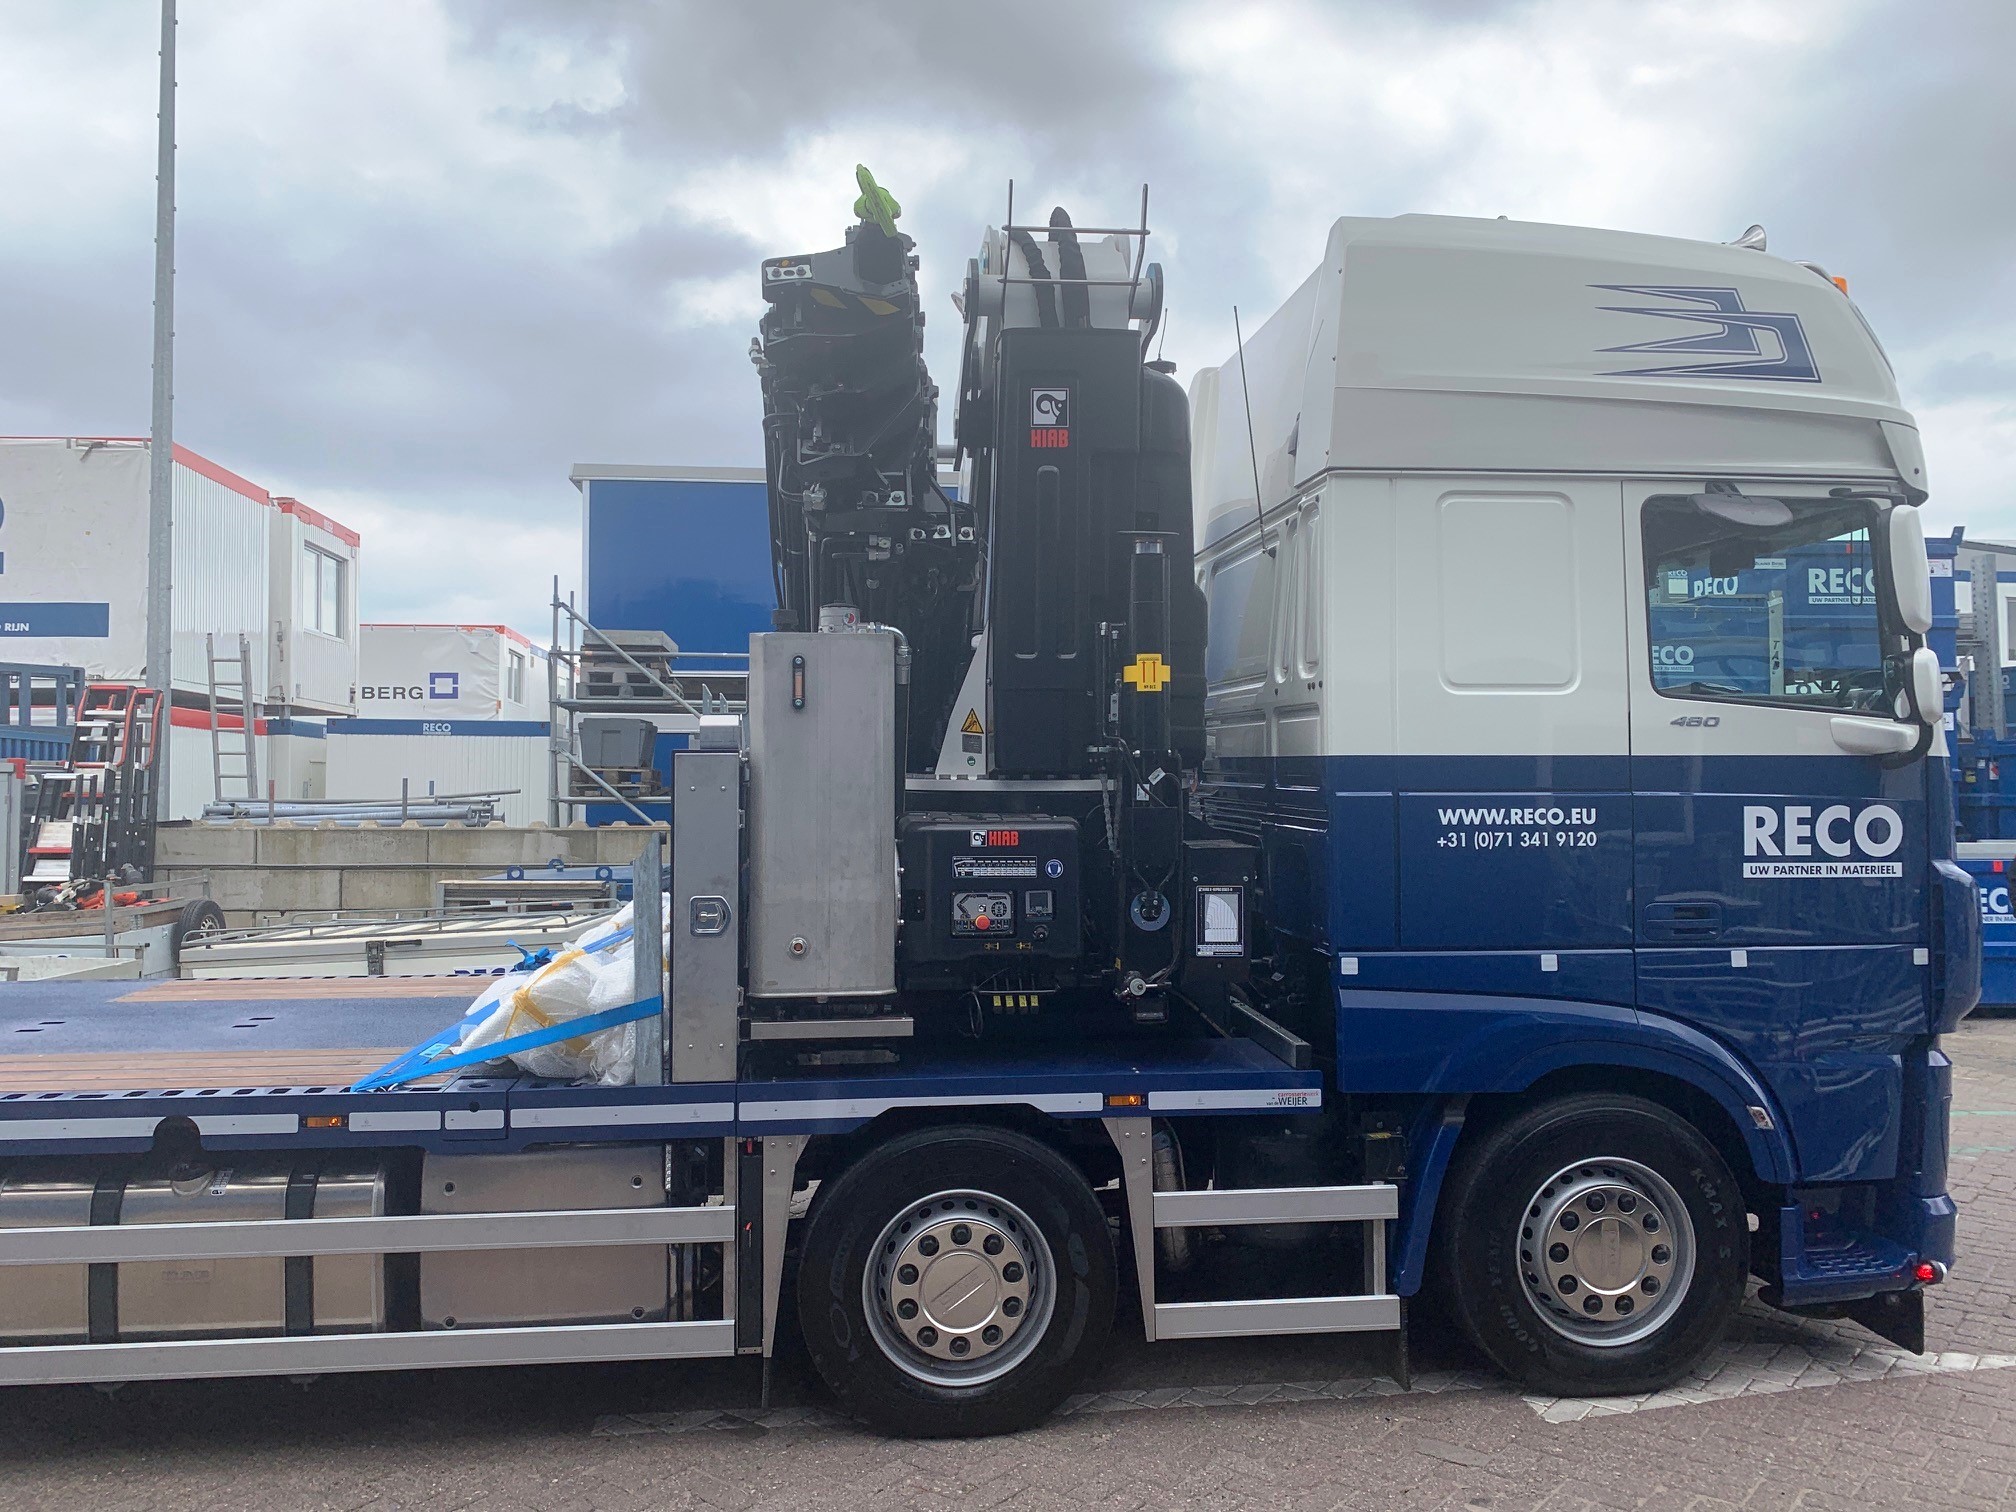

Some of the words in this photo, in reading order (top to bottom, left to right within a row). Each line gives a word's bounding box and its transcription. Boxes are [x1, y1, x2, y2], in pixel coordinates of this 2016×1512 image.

[1031, 429, 1069, 448] HIAB
[4, 622, 30, 632] RIJN
[361, 686, 424, 700] BERG
[422, 722, 452, 732] RECO
[1670, 716, 1720, 727] 480
[1437, 807, 1597, 826] WWW.RECO.EU
[1743, 804, 1904, 858] RECO
[988, 831, 1019, 846] HIAB
[1437, 831, 1466, 848] +31
[1474, 831, 1514, 850] (0)71
[1520, 831, 1549, 847] 341
[1556, 831, 1597, 847] 9120
[1749, 865, 1770, 876] UW
[1773, 865, 1822, 876] PARTNER
[1825, 865, 1838, 875] IN
[1841, 865, 1896, 875] MATERIEEL
[1278, 1096, 1308, 1106] WEIJER
